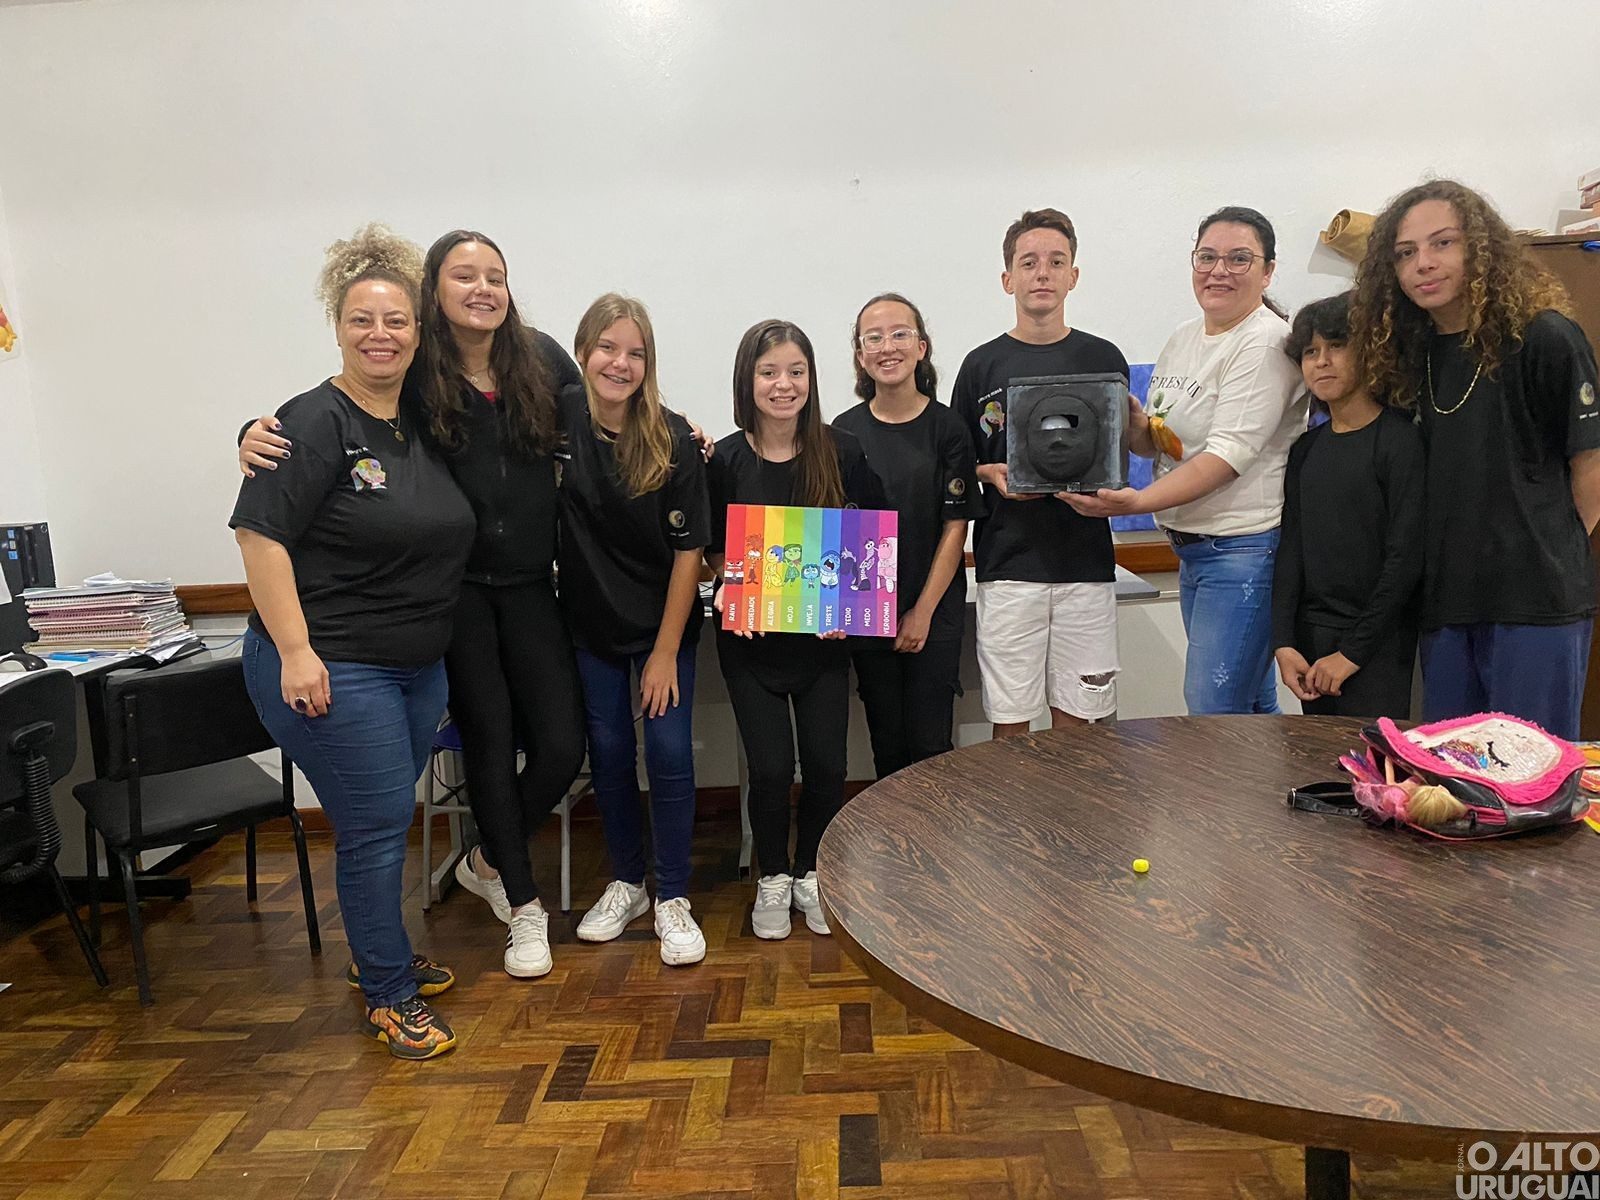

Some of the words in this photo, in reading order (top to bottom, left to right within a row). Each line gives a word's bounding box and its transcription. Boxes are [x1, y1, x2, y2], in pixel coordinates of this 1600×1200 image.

[728, 603, 736, 622] RAIVA
[767, 600, 775, 626] ALEGRIA
[786, 605, 794, 623] NOJO
[825, 604, 833, 627] TRISTE
[863, 607, 871, 627] MEDO
